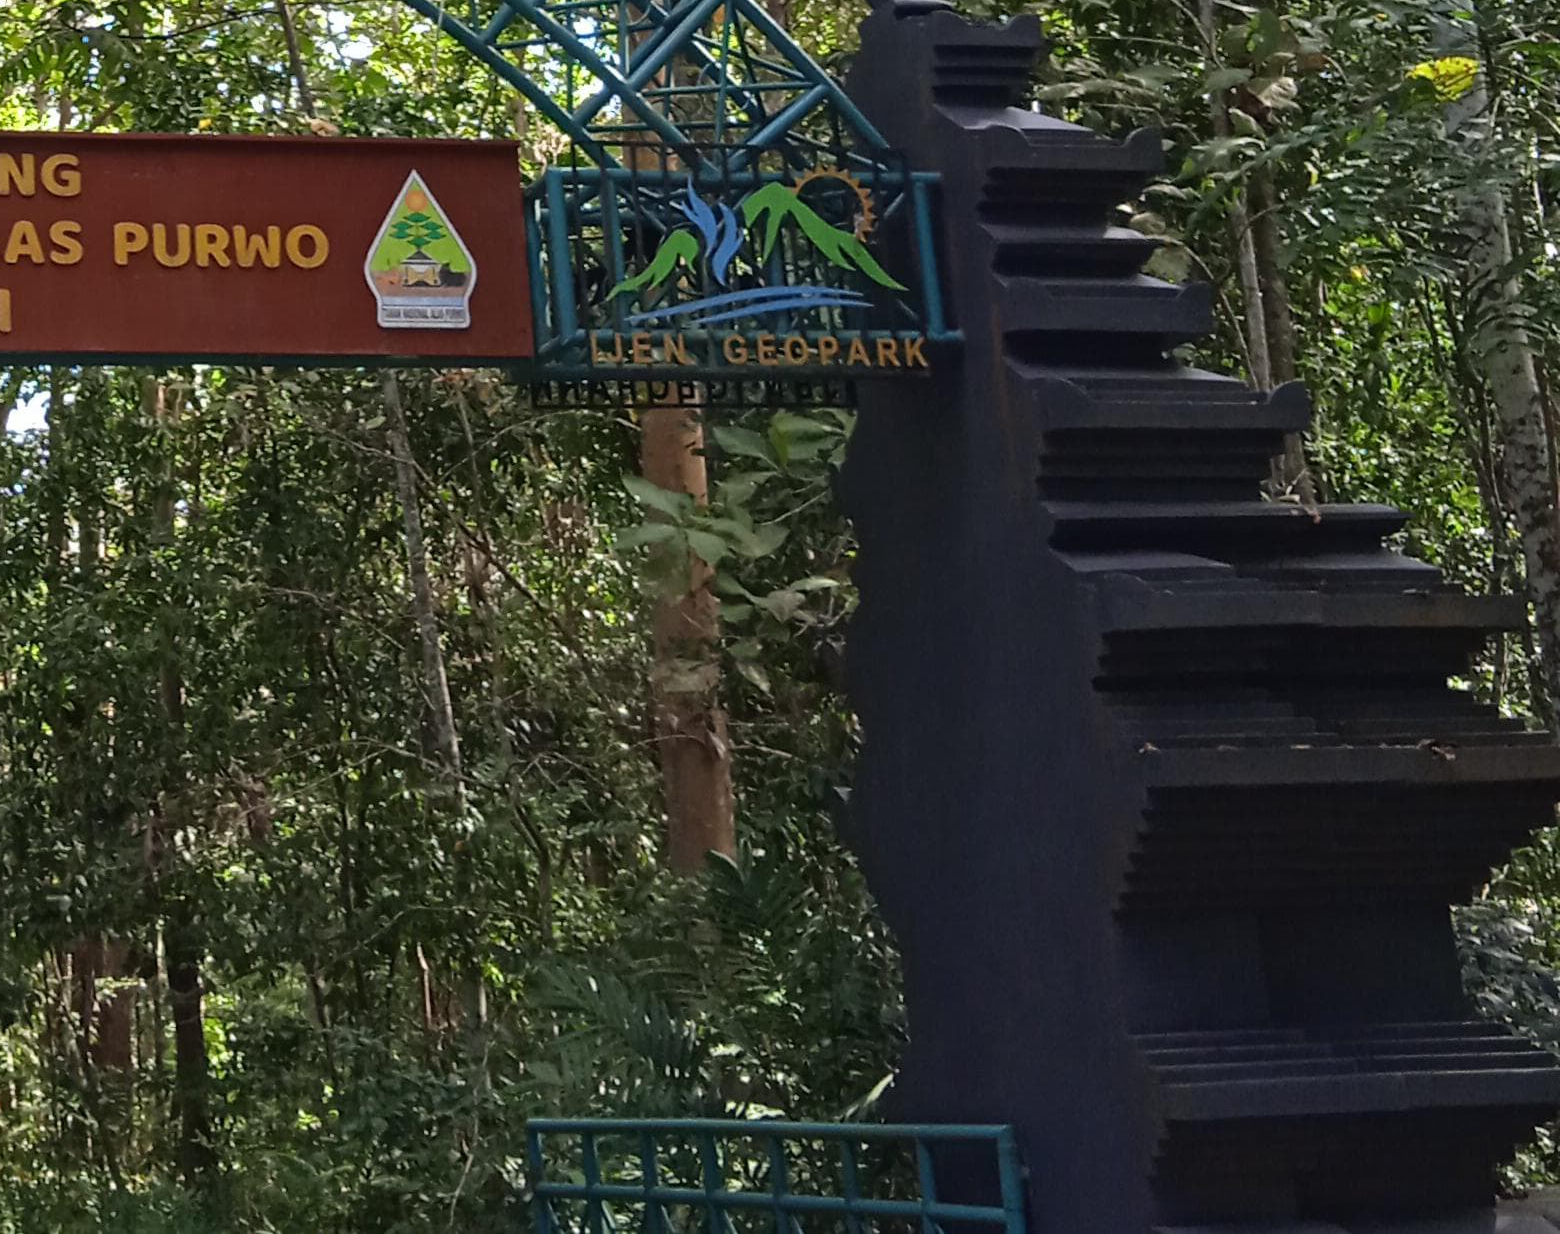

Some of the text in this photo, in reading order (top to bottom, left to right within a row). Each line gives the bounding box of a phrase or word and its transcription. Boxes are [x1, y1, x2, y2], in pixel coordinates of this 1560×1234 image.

[113, 221, 330, 270] PURWO
[590, 333, 929, 367] IJEN GEOPARK
